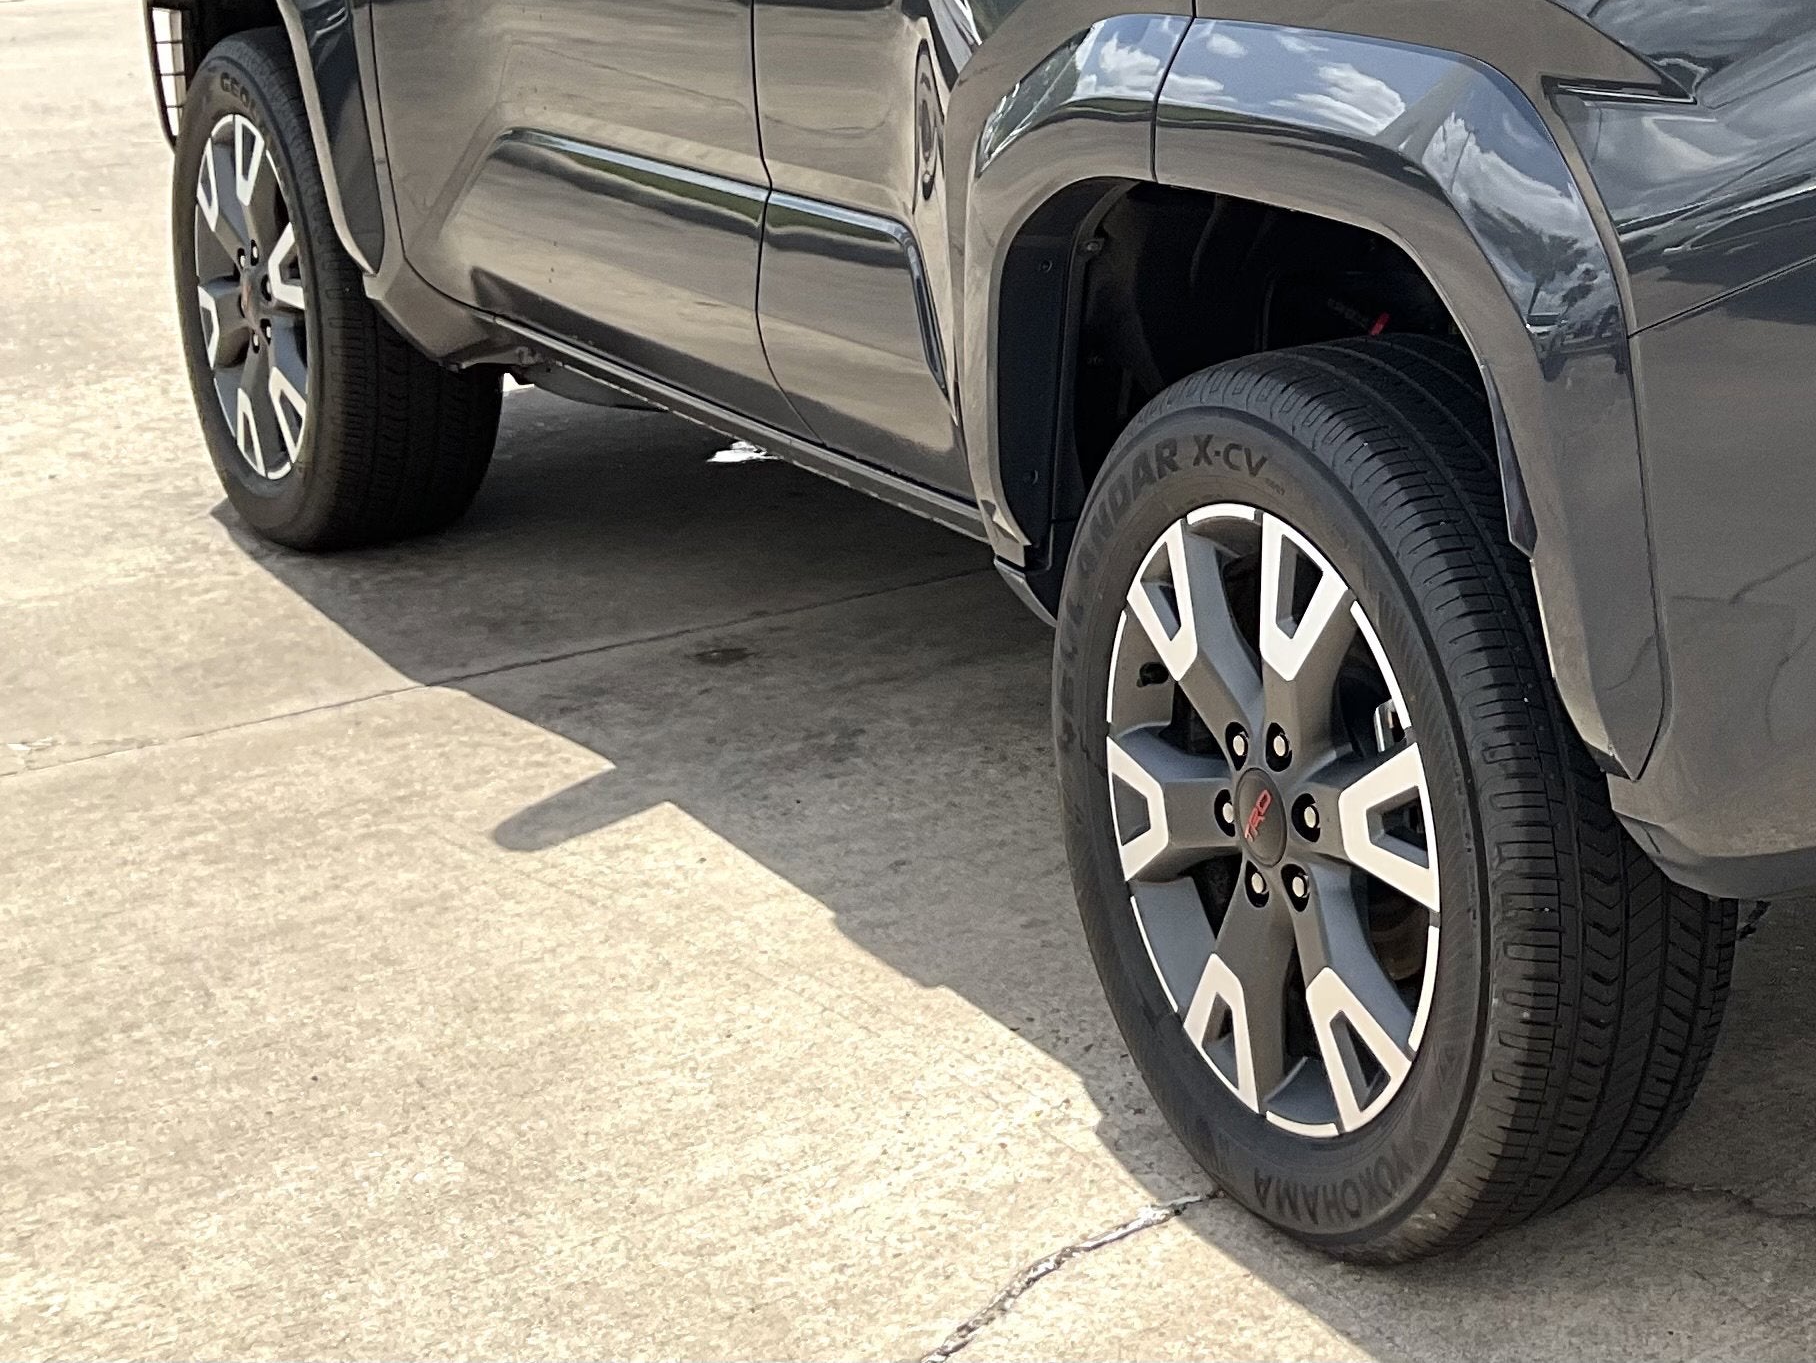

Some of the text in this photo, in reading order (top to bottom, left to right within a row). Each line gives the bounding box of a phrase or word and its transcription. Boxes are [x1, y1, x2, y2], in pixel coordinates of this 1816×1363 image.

[1192, 434, 1268, 477] X-CV
[1245, 790, 1272, 842] TRD
[1254, 1145, 1413, 1225] YOKOHAMA
